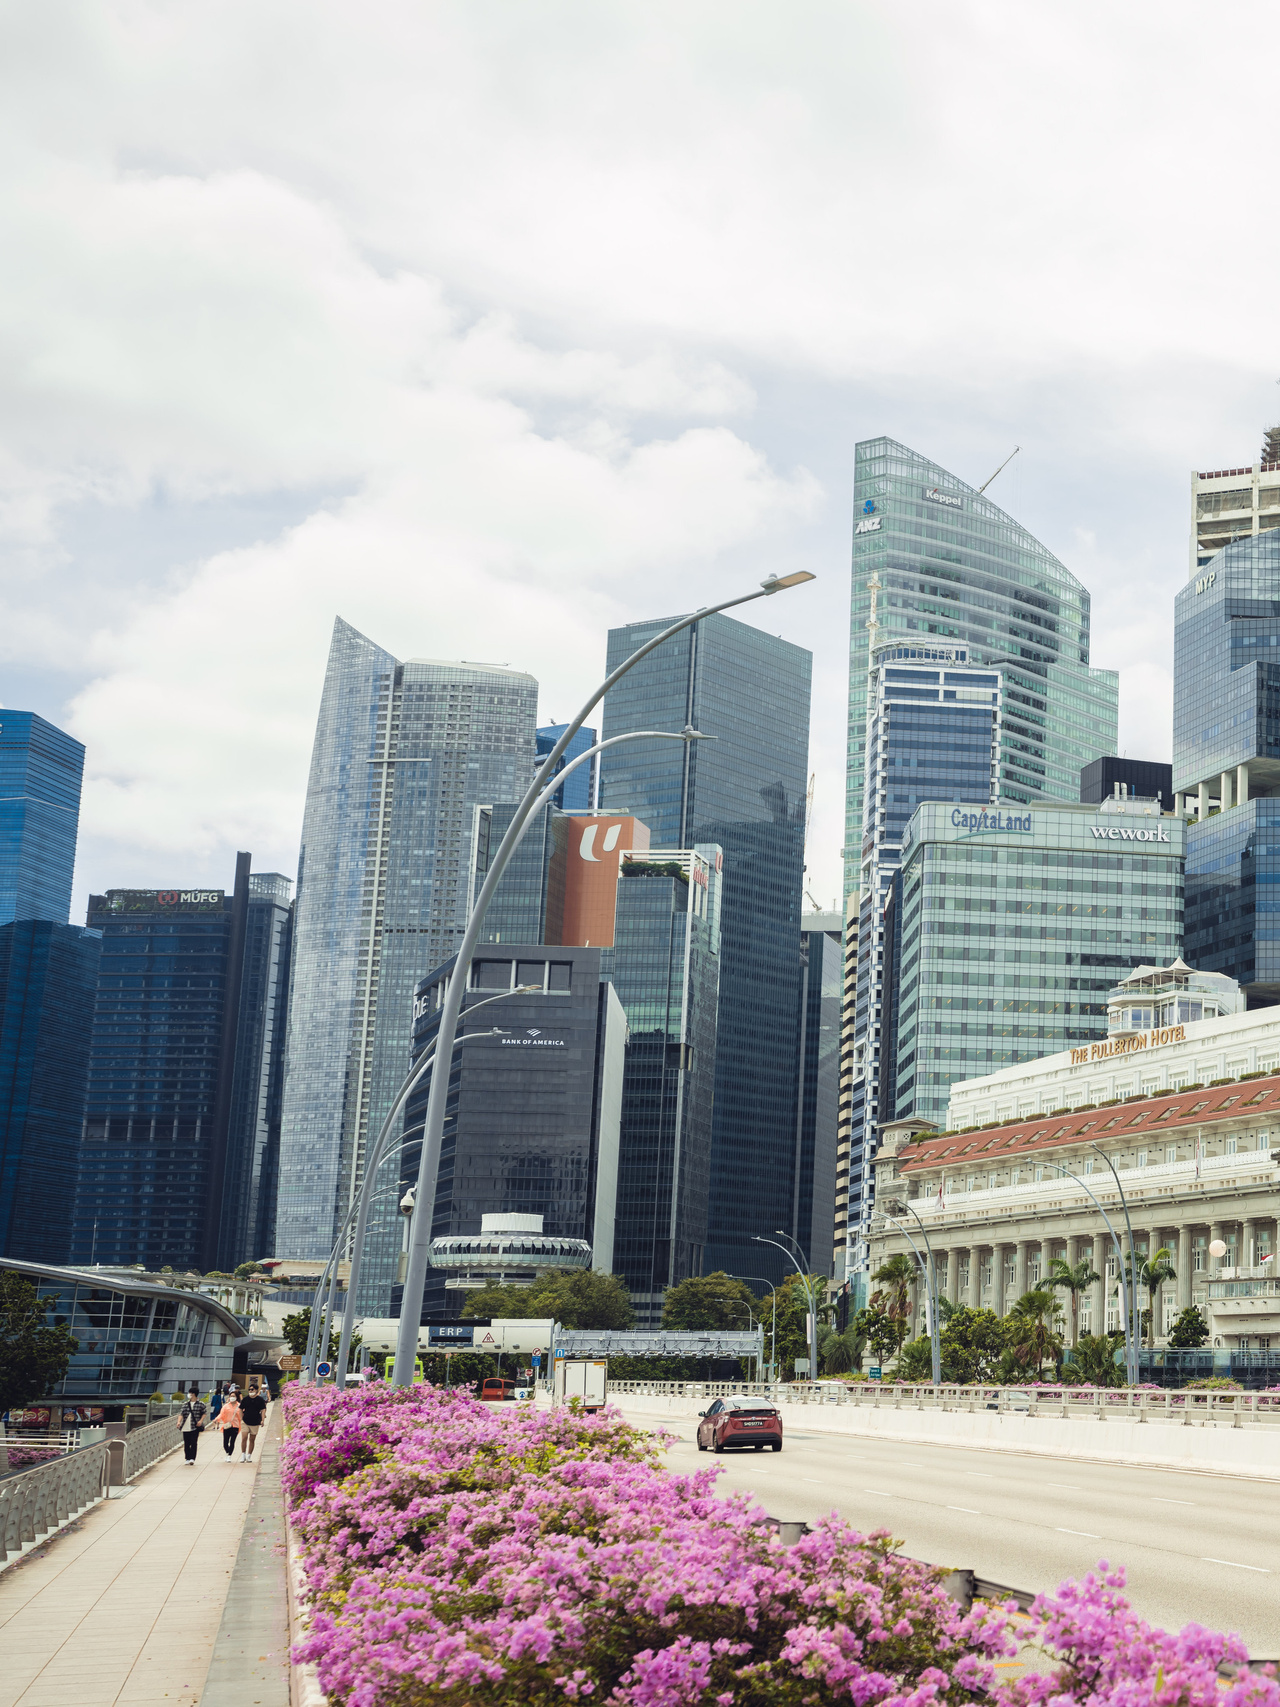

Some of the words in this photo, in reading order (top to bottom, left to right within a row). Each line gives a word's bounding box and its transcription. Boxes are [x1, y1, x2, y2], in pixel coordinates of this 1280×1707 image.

[926, 488, 962, 506] Keppel
[855, 518, 881, 534] ANZ
[1196, 572, 1216, 595] MYP
[951, 807, 1032, 832] CapitaLand
[1090, 824, 1170, 842] wework
[180, 892, 218, 903] MUFG
[1070, 1048, 1088, 1065] THE
[1091, 1033, 1147, 1060] FULLERTON
[1150, 1025, 1187, 1047] HOTEL
[439, 1327, 463, 1336] ERP
